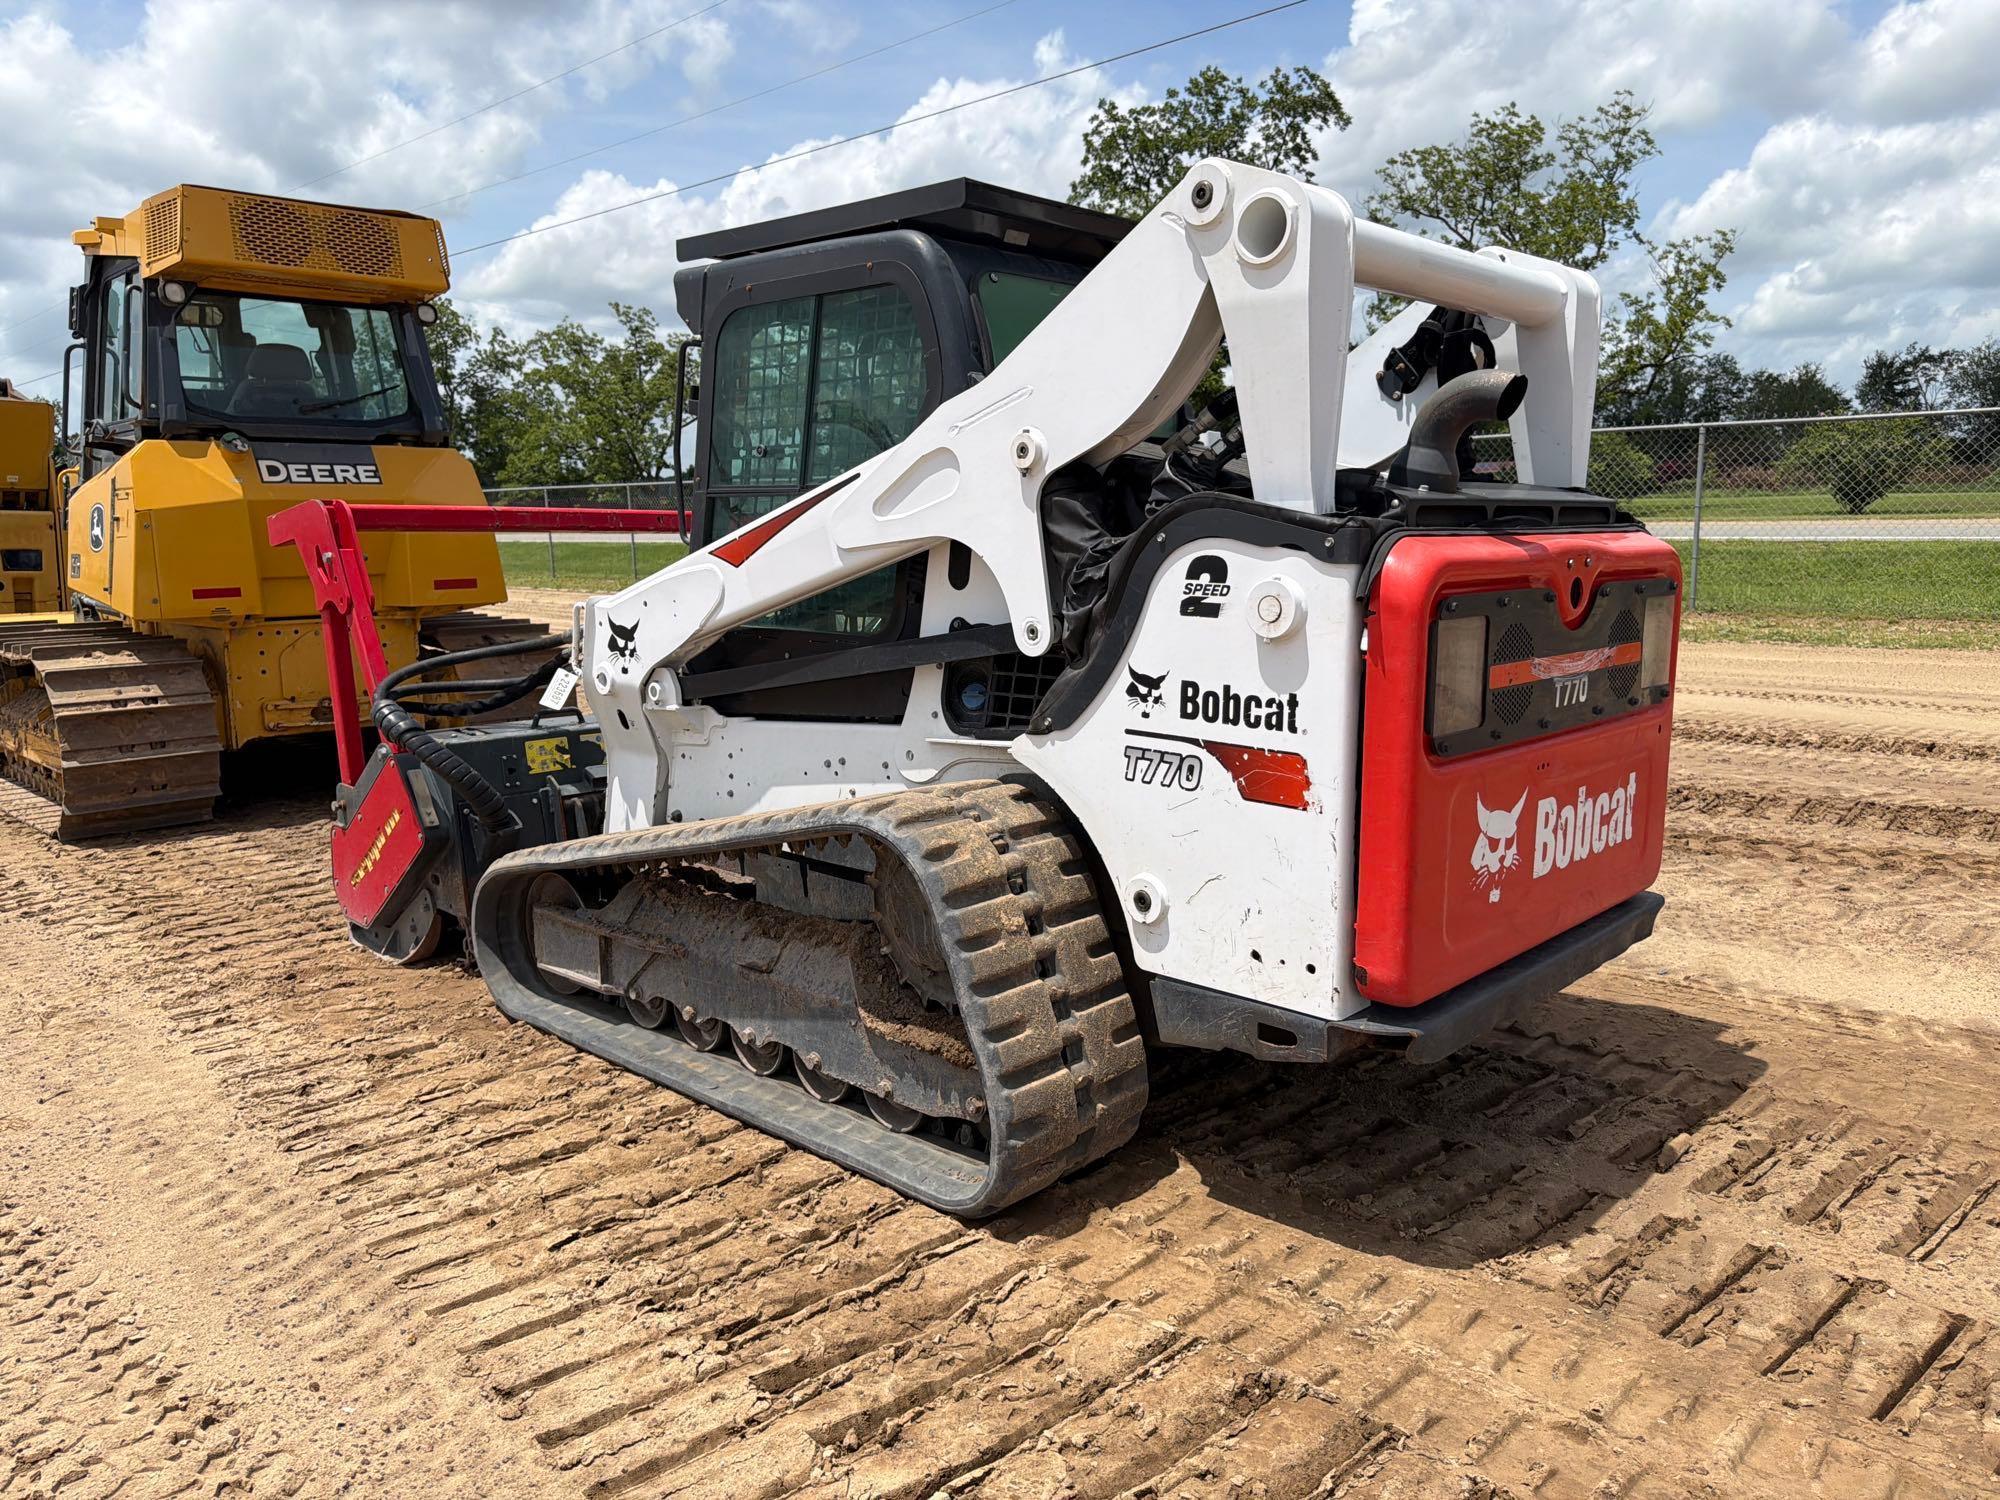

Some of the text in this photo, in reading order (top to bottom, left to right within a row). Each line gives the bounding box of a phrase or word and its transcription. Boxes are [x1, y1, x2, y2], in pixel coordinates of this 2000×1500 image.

[257, 459, 381, 484] DEERE
[1180, 554, 1229, 619] 2
[1183, 582, 1231, 597] SPEED
[1179, 679, 1299, 734] Bobcat
[1554, 675, 1589, 708] T770
[1124, 745, 1203, 792] T770
[1533, 771, 1636, 880] Bobcat
